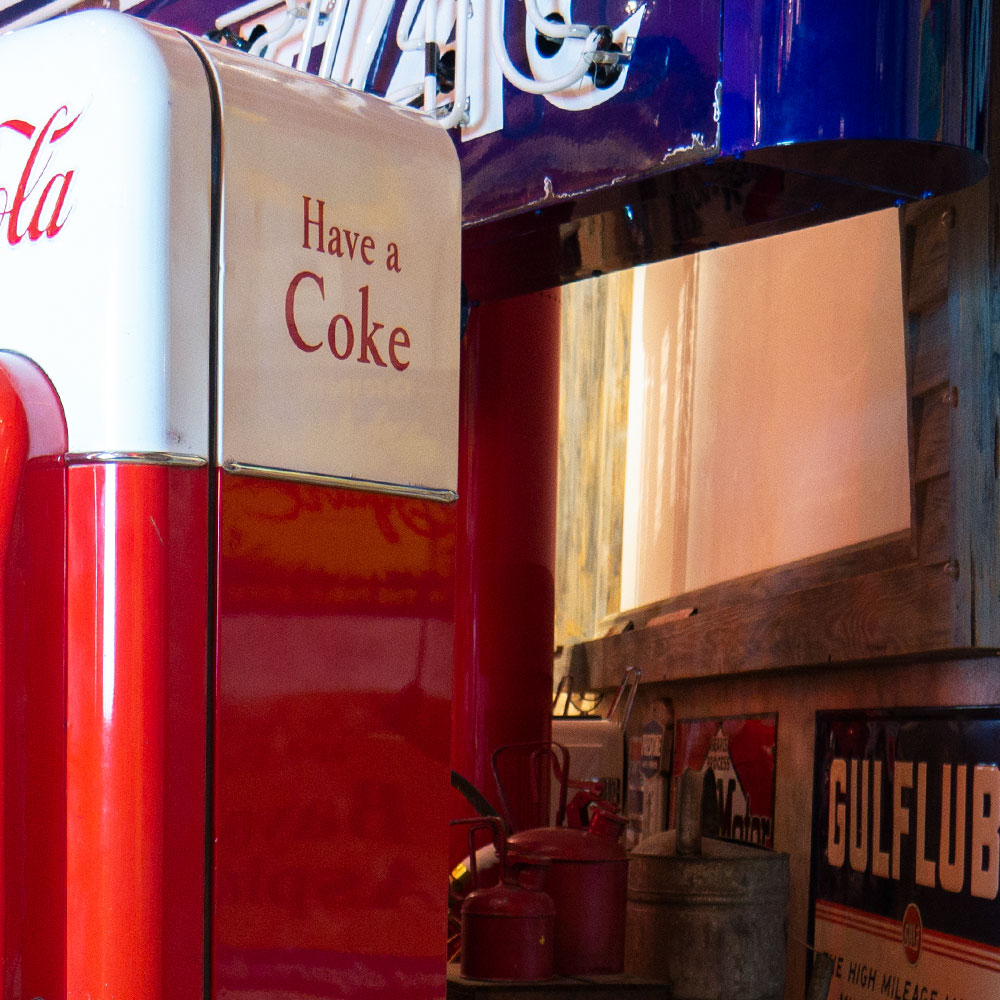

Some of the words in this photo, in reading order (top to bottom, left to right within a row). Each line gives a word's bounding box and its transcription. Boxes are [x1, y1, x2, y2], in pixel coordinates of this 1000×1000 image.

[302, 195, 376, 266] Have
[386, 241, 402, 274] a
[285, 271, 411, 371] Coke
[828, 758, 1000, 901] GULFLUB
[848, 962, 877, 991] HIGH
